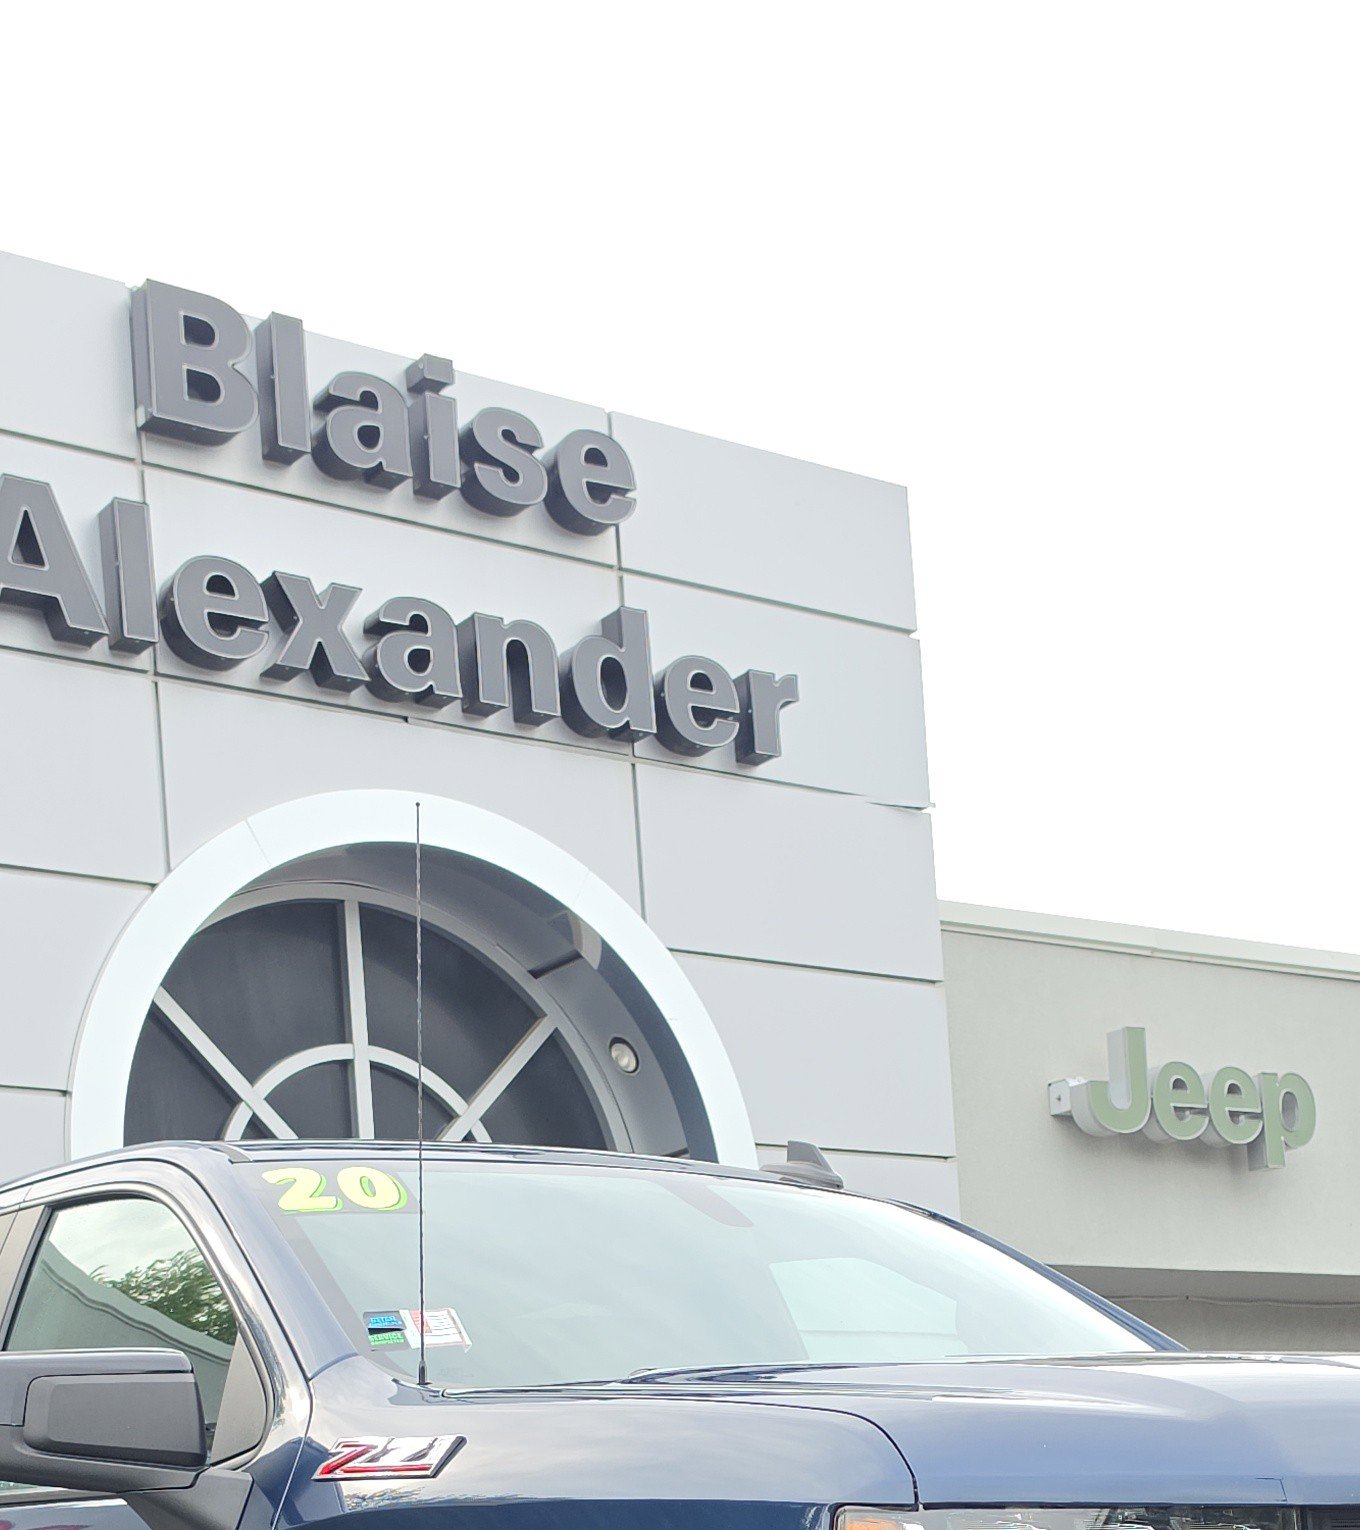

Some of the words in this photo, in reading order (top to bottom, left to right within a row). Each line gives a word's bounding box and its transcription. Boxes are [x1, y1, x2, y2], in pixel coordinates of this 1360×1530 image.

[128, 279, 637, 536] Blaise
[1074, 1026, 1317, 1170] Jeep
[261, 1166, 408, 1214] 20
[312, 1435, 467, 1481] Z71
